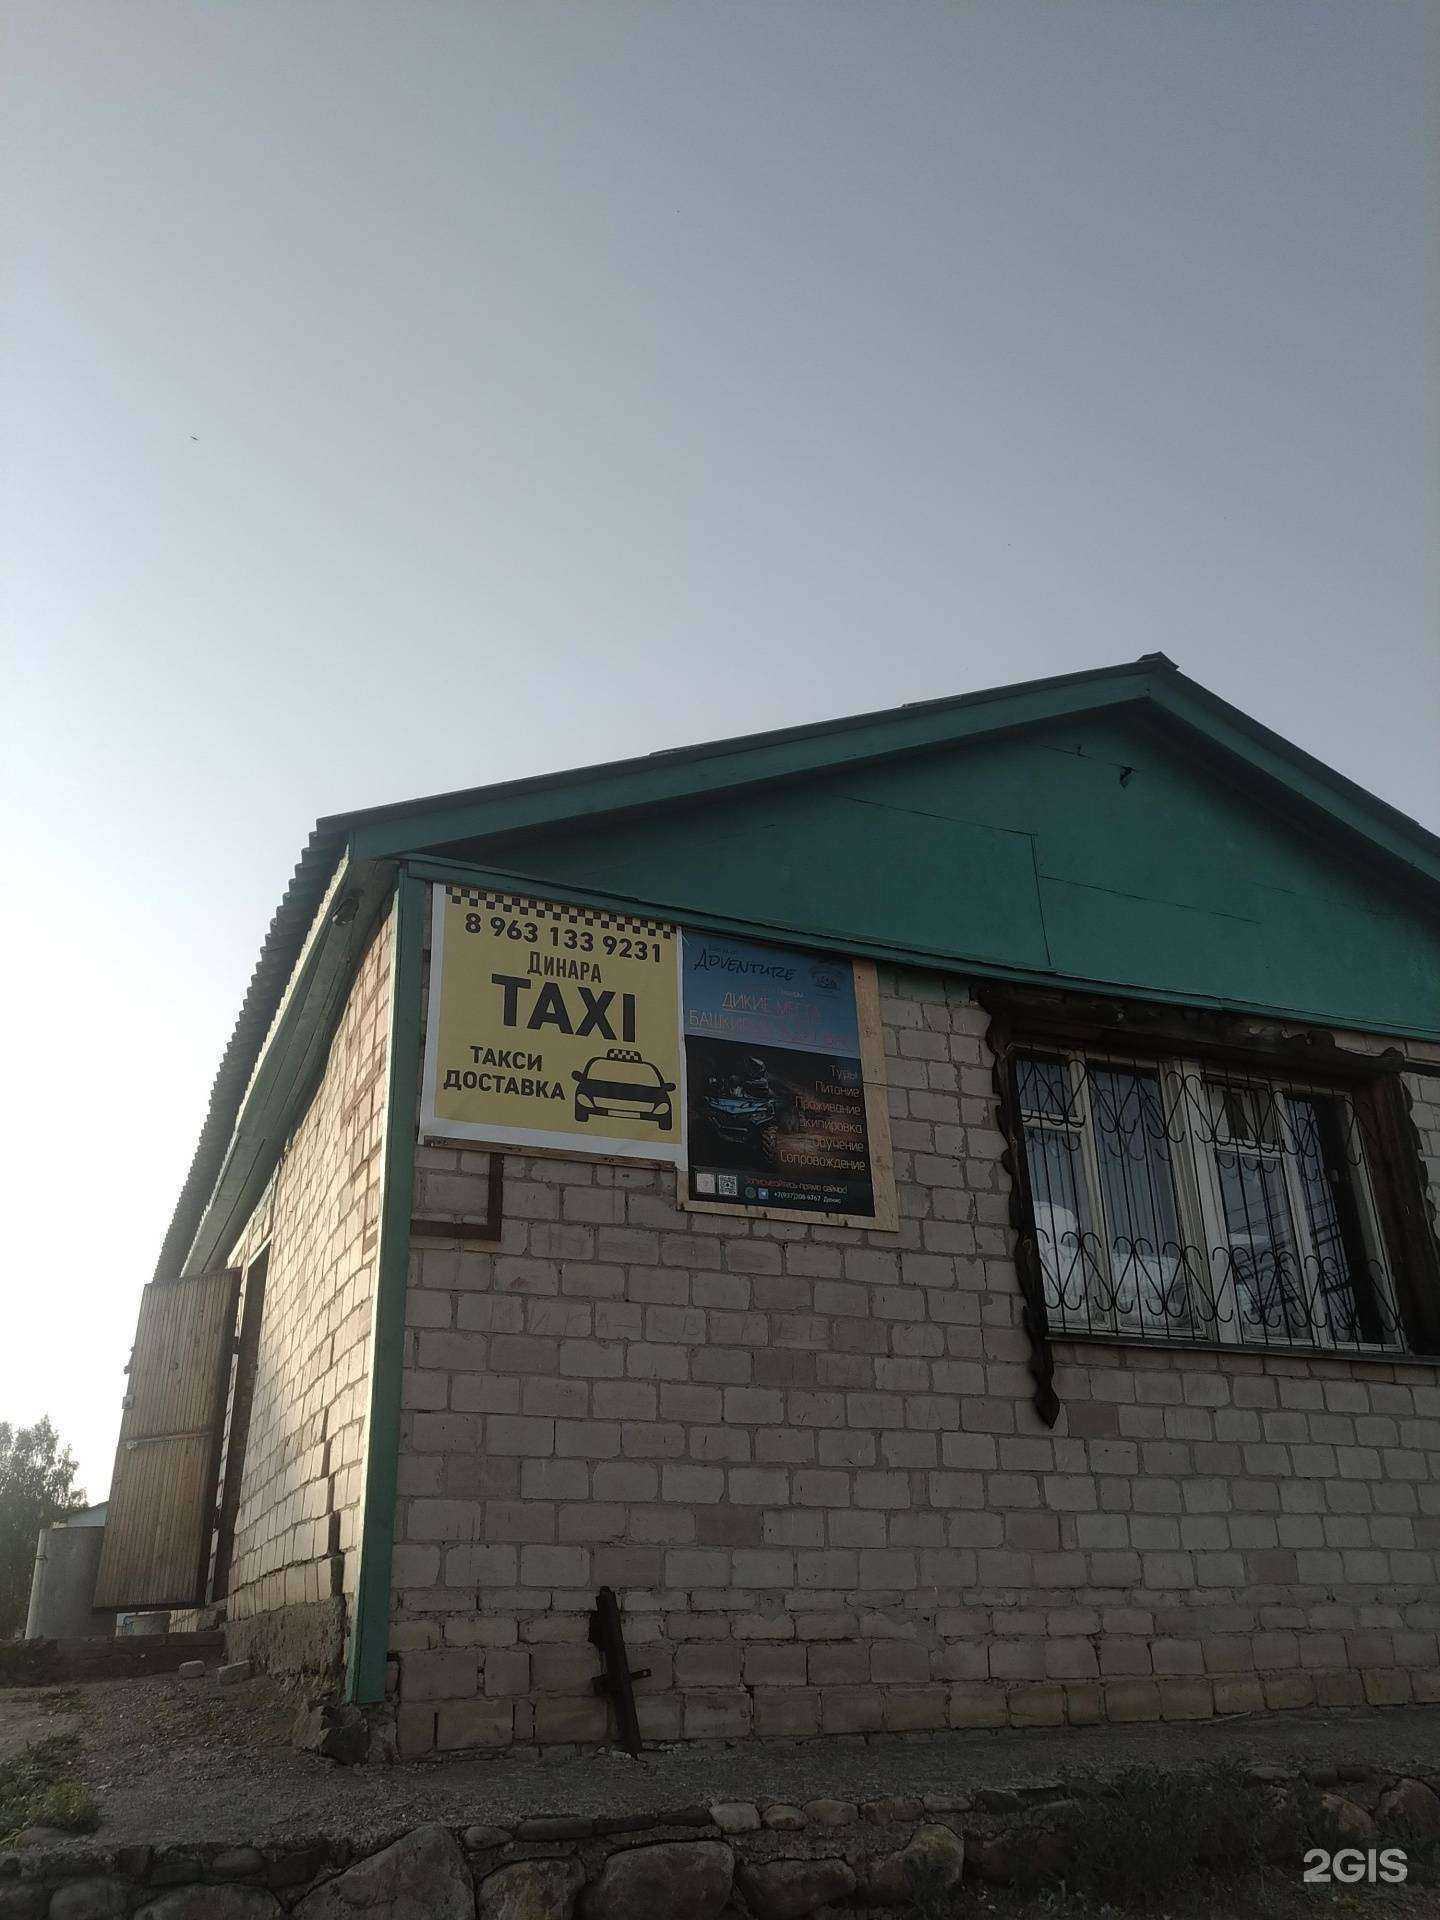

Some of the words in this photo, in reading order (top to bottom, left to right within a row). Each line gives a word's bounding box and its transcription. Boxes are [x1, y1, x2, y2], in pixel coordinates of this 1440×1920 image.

[464, 913, 481, 933] 8
[490, 917, 538, 943] 963
[550, 927, 594, 952] 133
[602, 935, 661, 963] 9231
[527, 950, 602, 983] ДИНАРА
[491, 974, 636, 1043] TAXI
[469, 1045, 543, 1072] ТАКСИ
[830, 1064, 858, 1080] Туры
[444, 1070, 566, 1101] ДОСТАВКА
[815, 1080, 860, 1098] Питание
[796, 1096, 861, 1115] Проживание
[780, 1151, 866, 1171] Сопровождение
